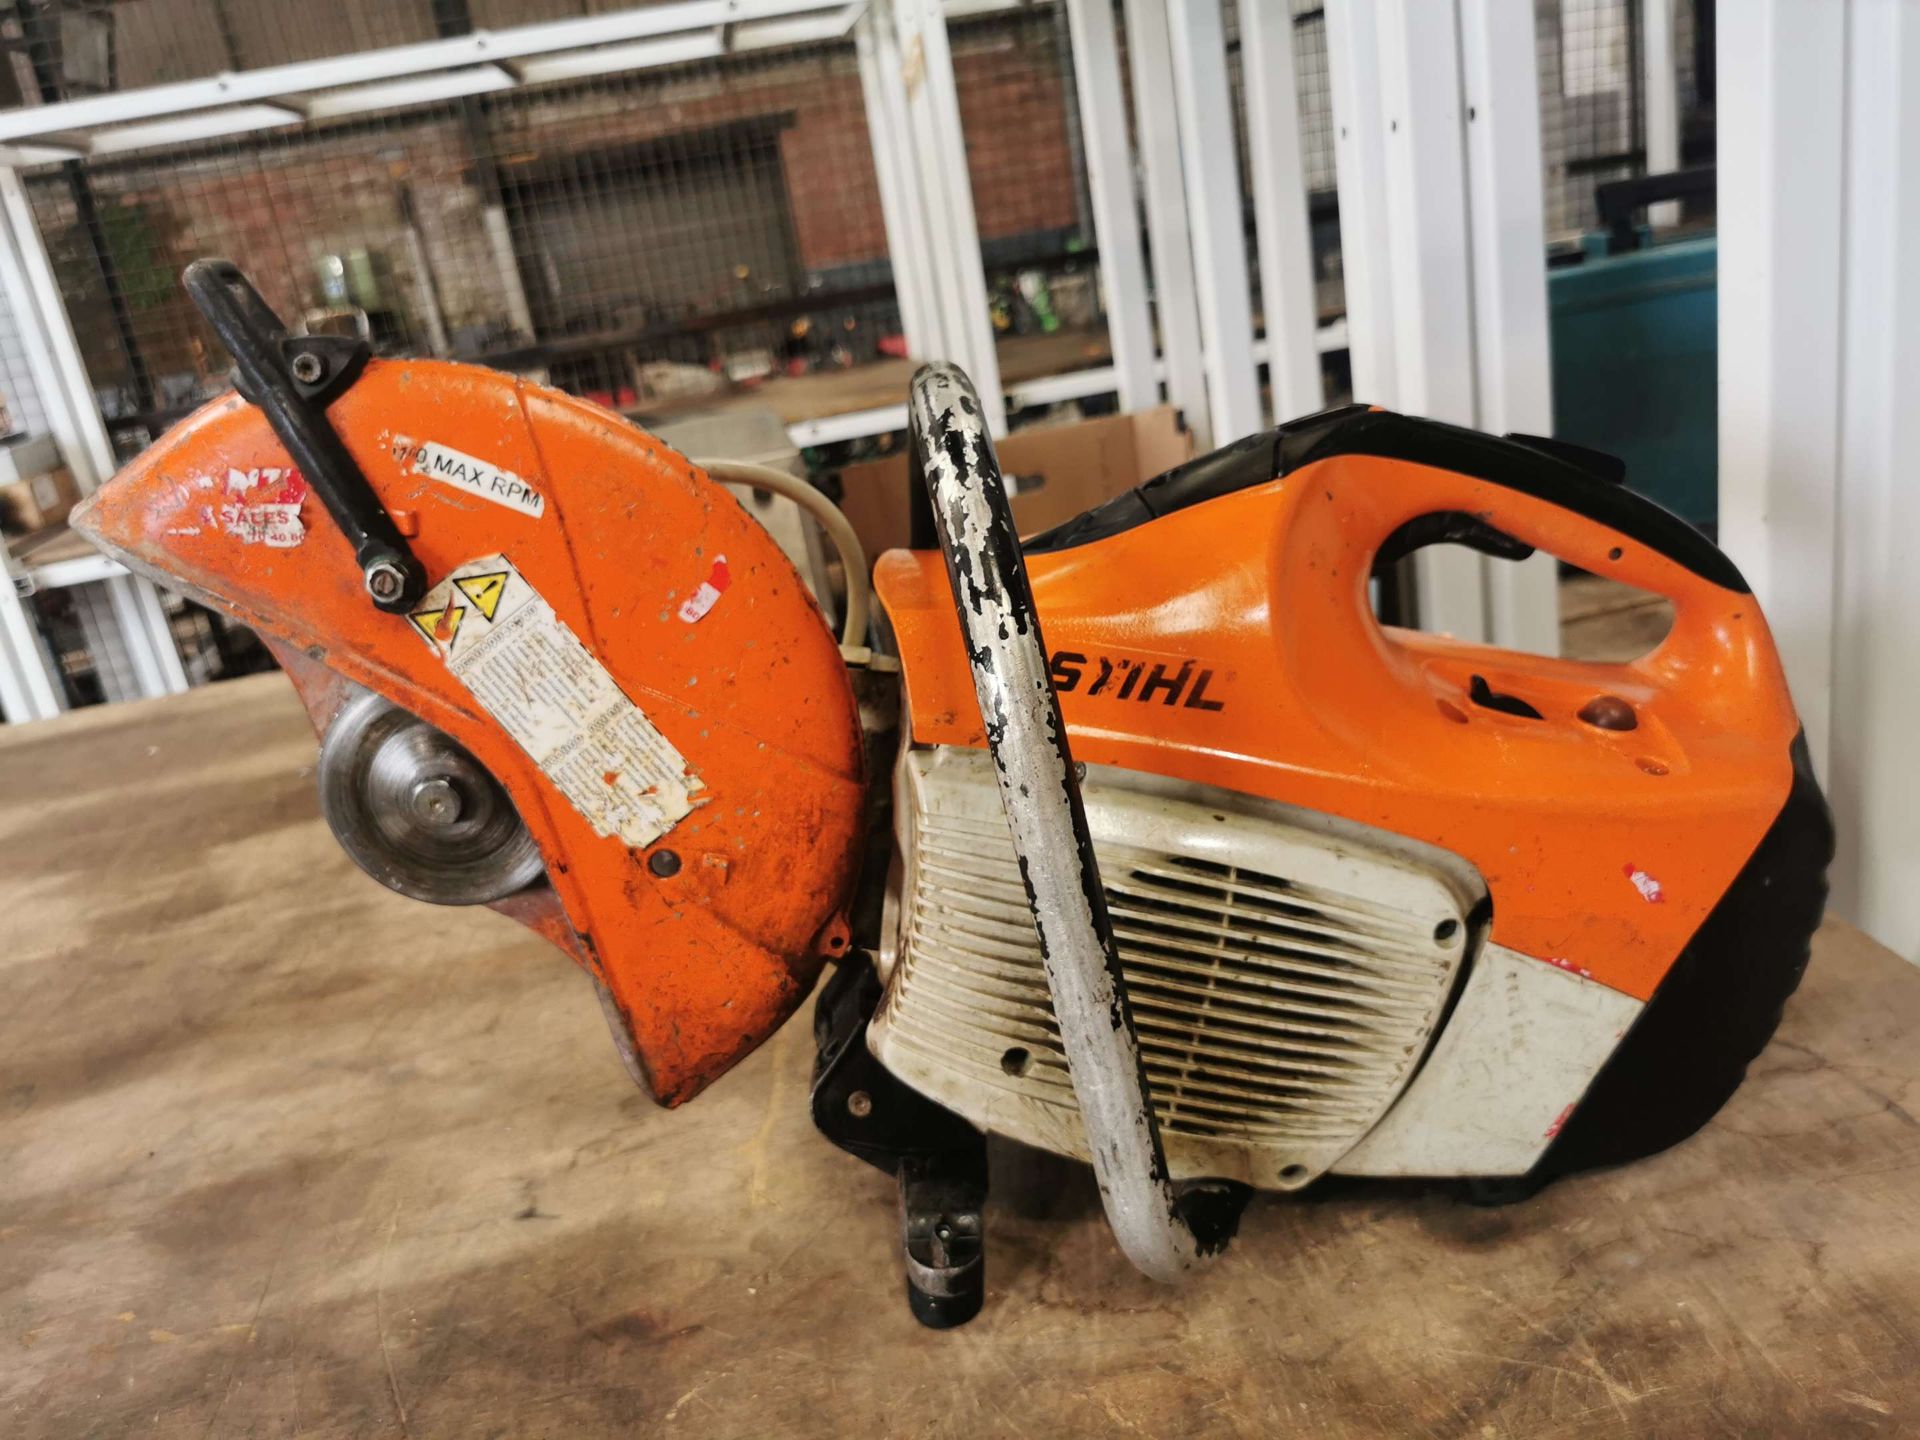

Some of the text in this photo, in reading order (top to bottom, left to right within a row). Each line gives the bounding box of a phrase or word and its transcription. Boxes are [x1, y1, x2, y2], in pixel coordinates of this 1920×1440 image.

[434, 454, 485, 487] MAX
[491, 476, 541, 509] RPM
[221, 509, 289, 526] SALES
[1049, 651, 1225, 712] STIHL
